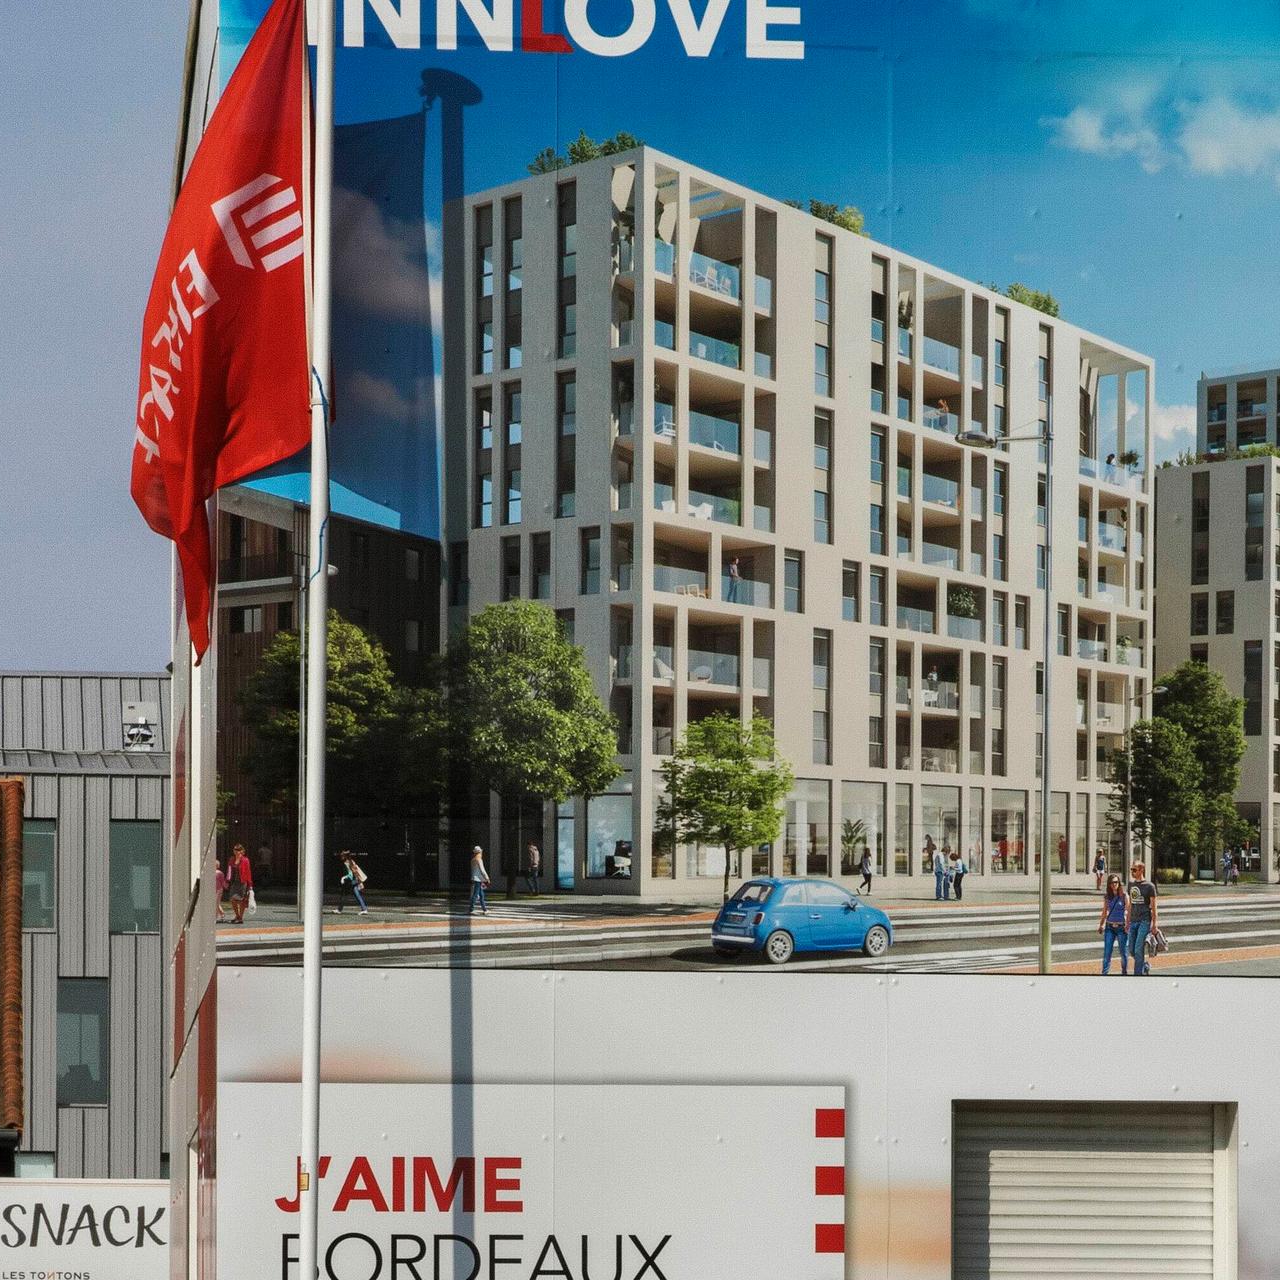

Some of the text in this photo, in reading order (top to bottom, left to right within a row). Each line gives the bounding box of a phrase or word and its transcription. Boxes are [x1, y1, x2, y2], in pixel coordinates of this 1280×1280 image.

[306, 0, 805, 59] NNLOVE
[274, 1156, 523, 1213] J'AIME
[1, 1203, 168, 1248] SNACK
[2, 1271, 26, 1280] LES
